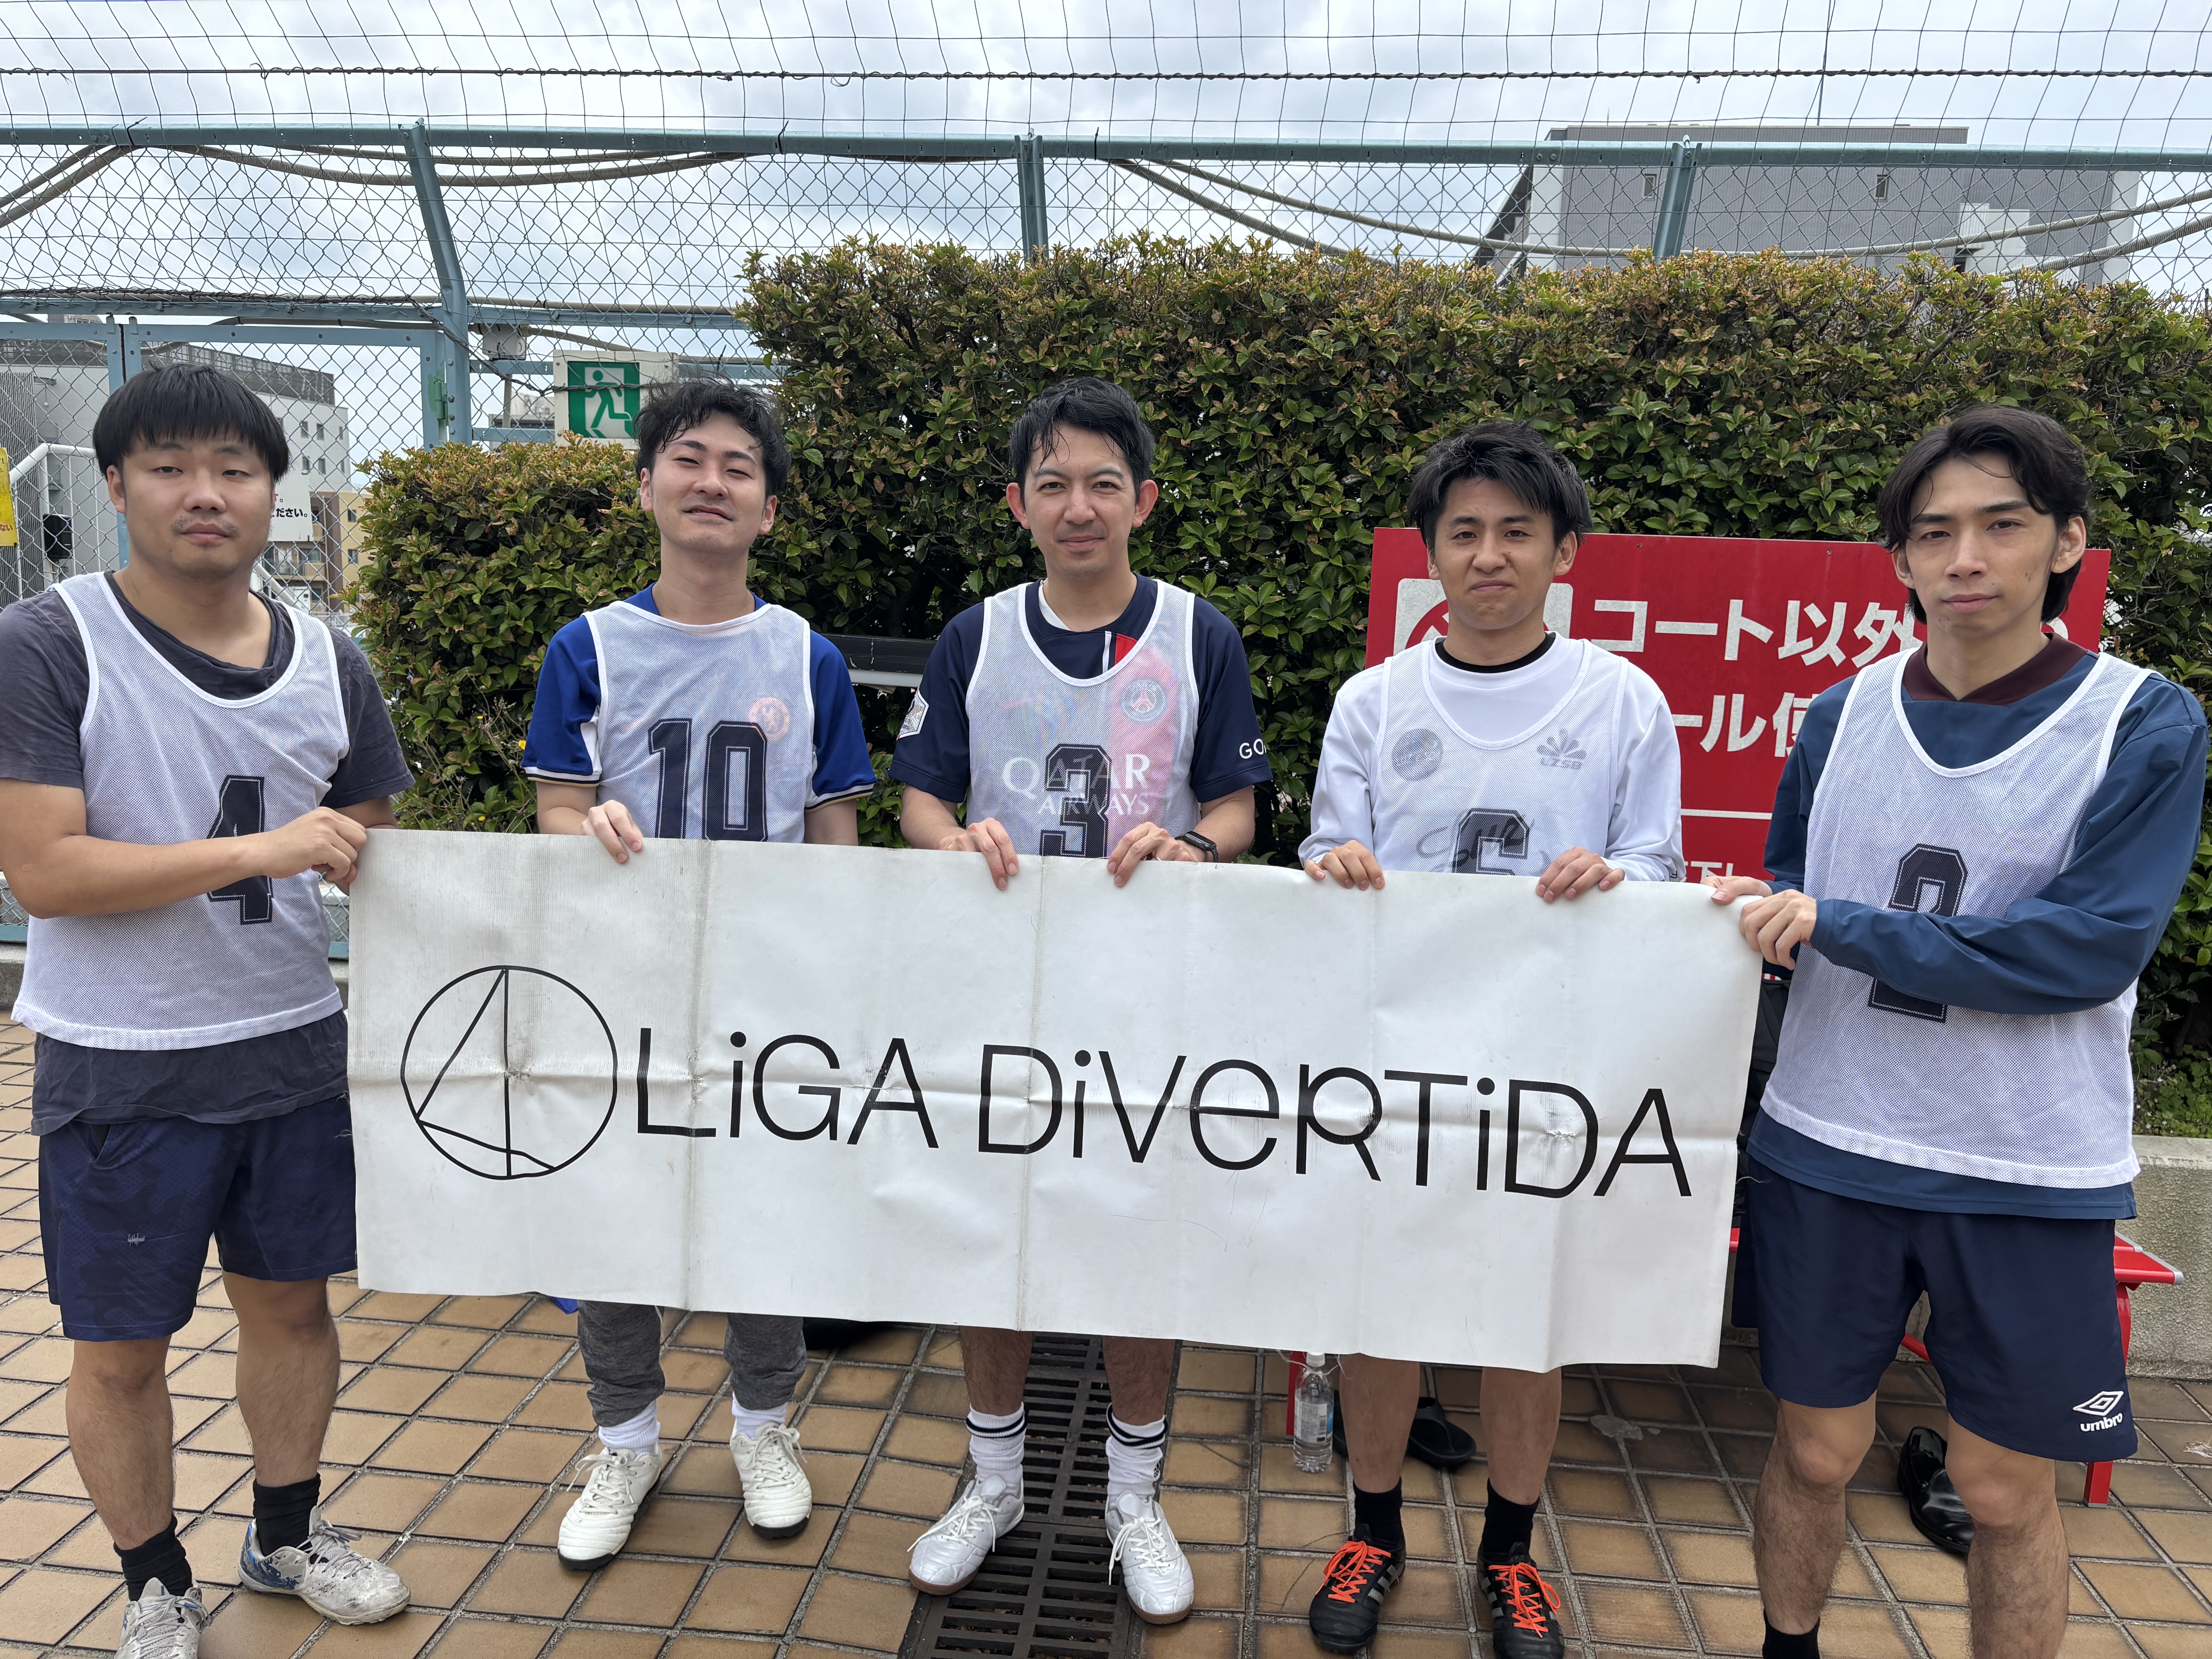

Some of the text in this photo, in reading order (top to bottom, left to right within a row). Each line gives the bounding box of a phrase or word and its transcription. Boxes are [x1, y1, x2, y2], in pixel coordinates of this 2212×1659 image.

[273, 508, 307, 517] ださい。
[649, 718, 768, 842] 10
[1239, 738, 1266, 759] GO
[1039, 743, 1111, 858] 3
[206, 775, 273, 925] 4
[2080, 1413, 2123, 1432] umbro
